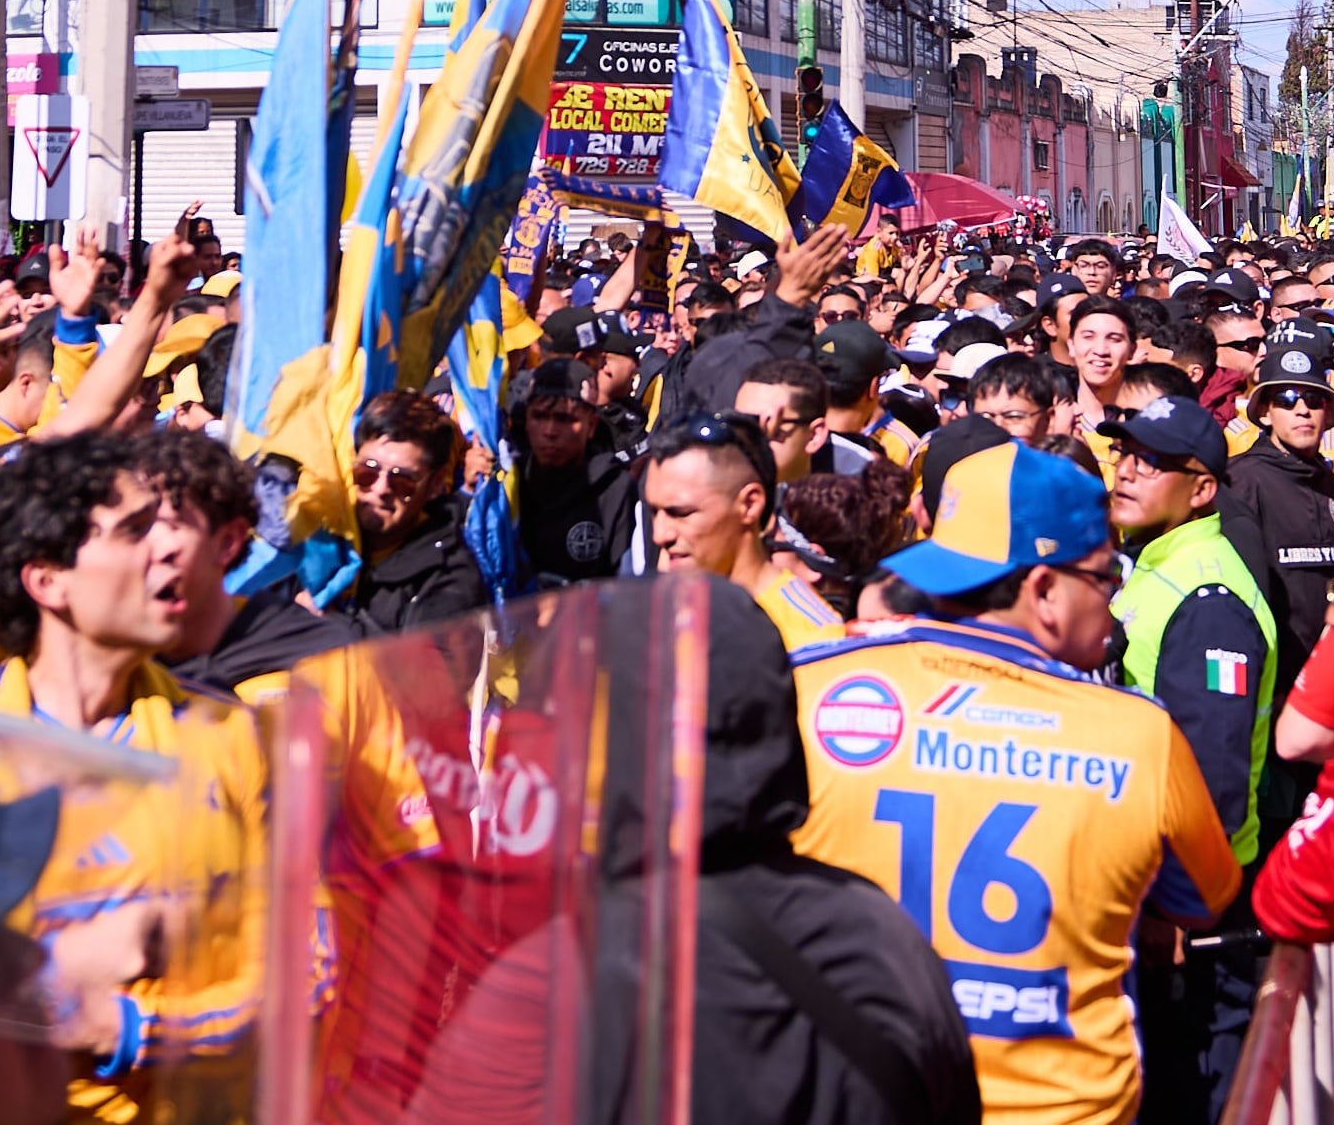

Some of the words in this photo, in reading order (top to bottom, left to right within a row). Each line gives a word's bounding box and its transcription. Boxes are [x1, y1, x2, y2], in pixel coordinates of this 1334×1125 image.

[602, 41, 658, 54] OFICINAS
[549, 108, 604, 132] LOCAL
[915, 728, 1129, 800] Monterrey
[872, 788, 1054, 956] 16
[951, 978, 1060, 1024] EPSI
